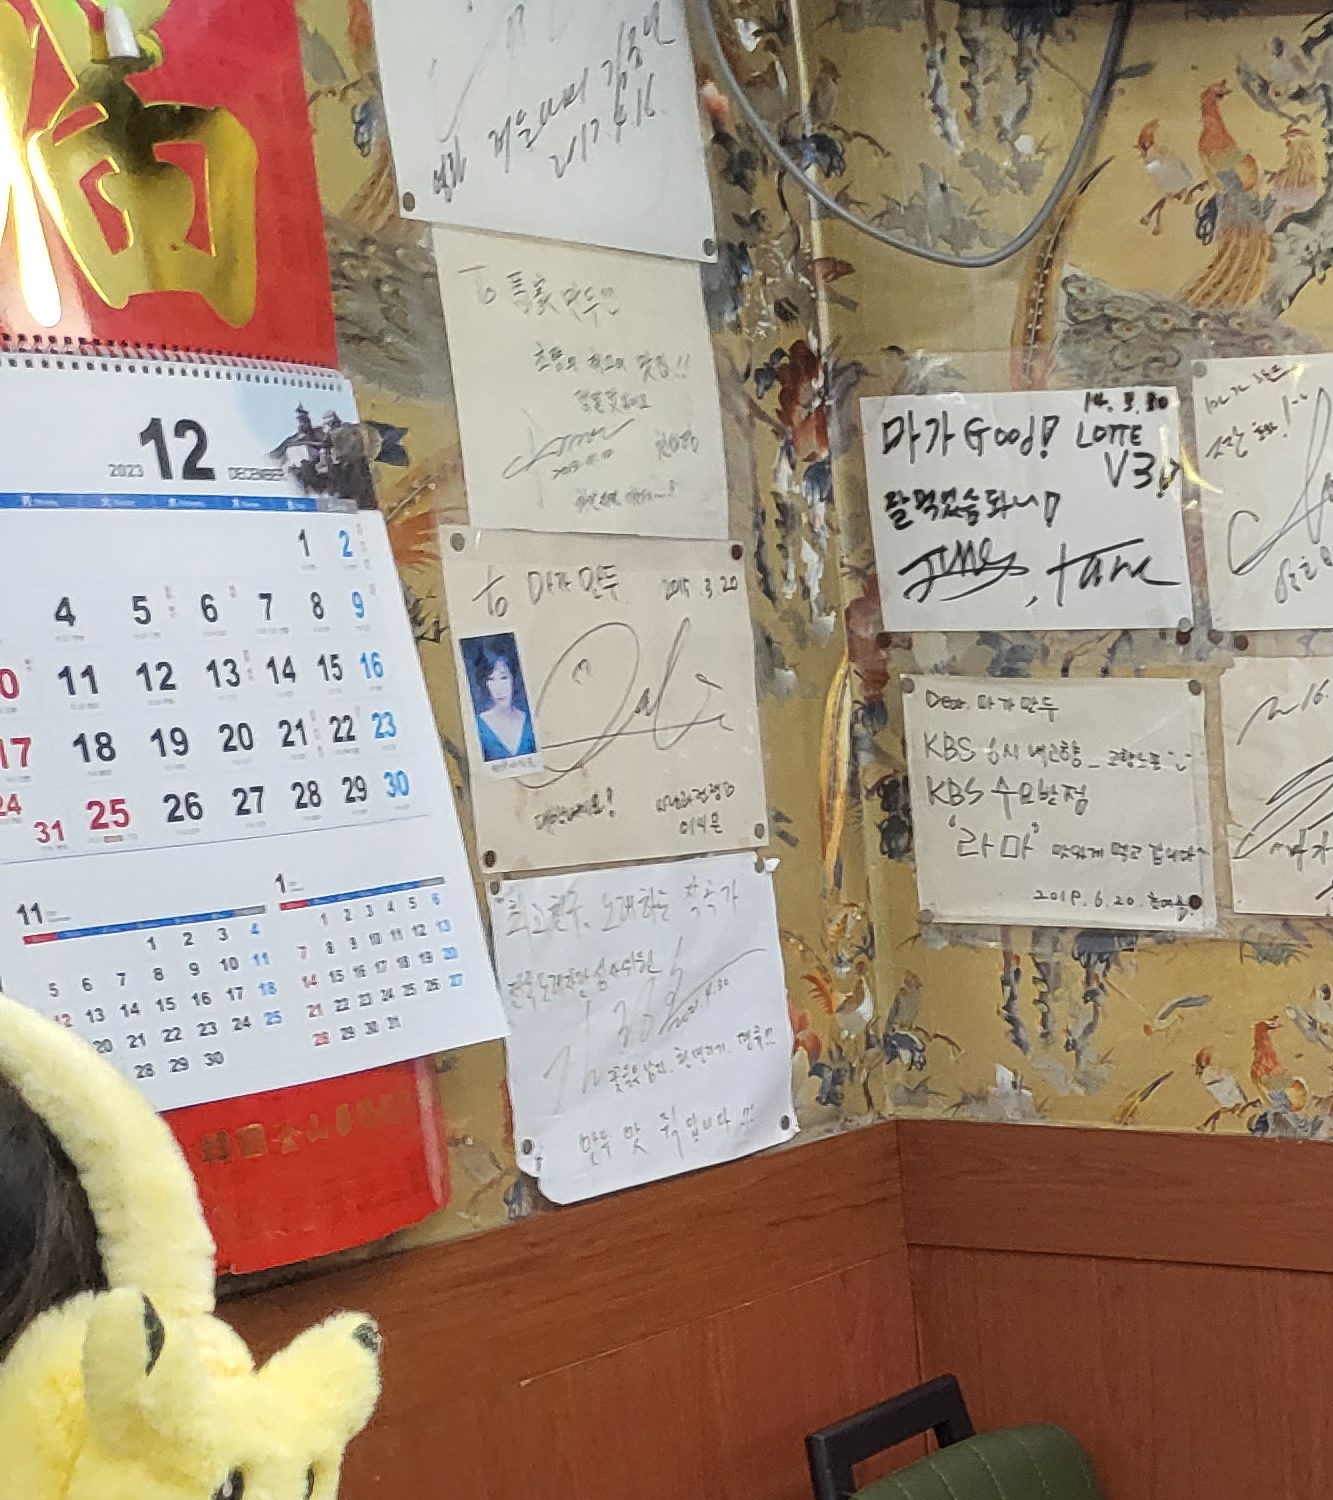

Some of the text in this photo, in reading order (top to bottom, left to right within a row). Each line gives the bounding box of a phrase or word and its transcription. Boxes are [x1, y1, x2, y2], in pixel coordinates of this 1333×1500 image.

[108, 463, 144, 479] 2023
[139, 417, 216, 481] 12
[881, 409, 1061, 464] 마가 Good!
[1076, 420, 1143, 449] LOTTE
[298, 528, 354, 558] 1 2
[54, 591, 365, 627] 4 5 6 7 8 9
[0, 651, 384, 700] 0 11 12 13 14 15 16
[72, 731, 117, 763] 18
[150, 726, 189, 757] 19
[218, 722, 254, 752] 20
[278, 717, 308, 747] 21
[329, 714, 357, 743] 22
[371, 711, 397, 739] 23
[923, 731, 977, 762] KBS
[86, 797, 130, 830] 25
[163, 791, 203, 823] 26
[232, 785, 264, 816] 27
[291, 780, 321, 810] 28
[342, 775, 368, 804] 29
[383, 769, 410, 798] 30
[925, 775, 985, 807] KBS
[34, 819, 65, 844] 31
[274, 872, 287, 894] 1
[17, 902, 43, 926] 11
[146, 936, 156, 951] 1
[182, 931, 195, 947] 2
[217, 927, 229, 942] 3
[48, 982, 60, 998] 5
[81, 977, 93, 992] 6
[116, 972, 127, 987] 7
[153, 967, 165, 982] 8
[188, 961, 200, 977] 9
[219, 956, 240, 972] 10
[85, 1007, 106, 1024] 13
[119, 1002, 141, 1018] 14
[155, 996, 177, 1013] 15
[191, 991, 213, 1007] 16
[226, 985, 244, 1001] 17
